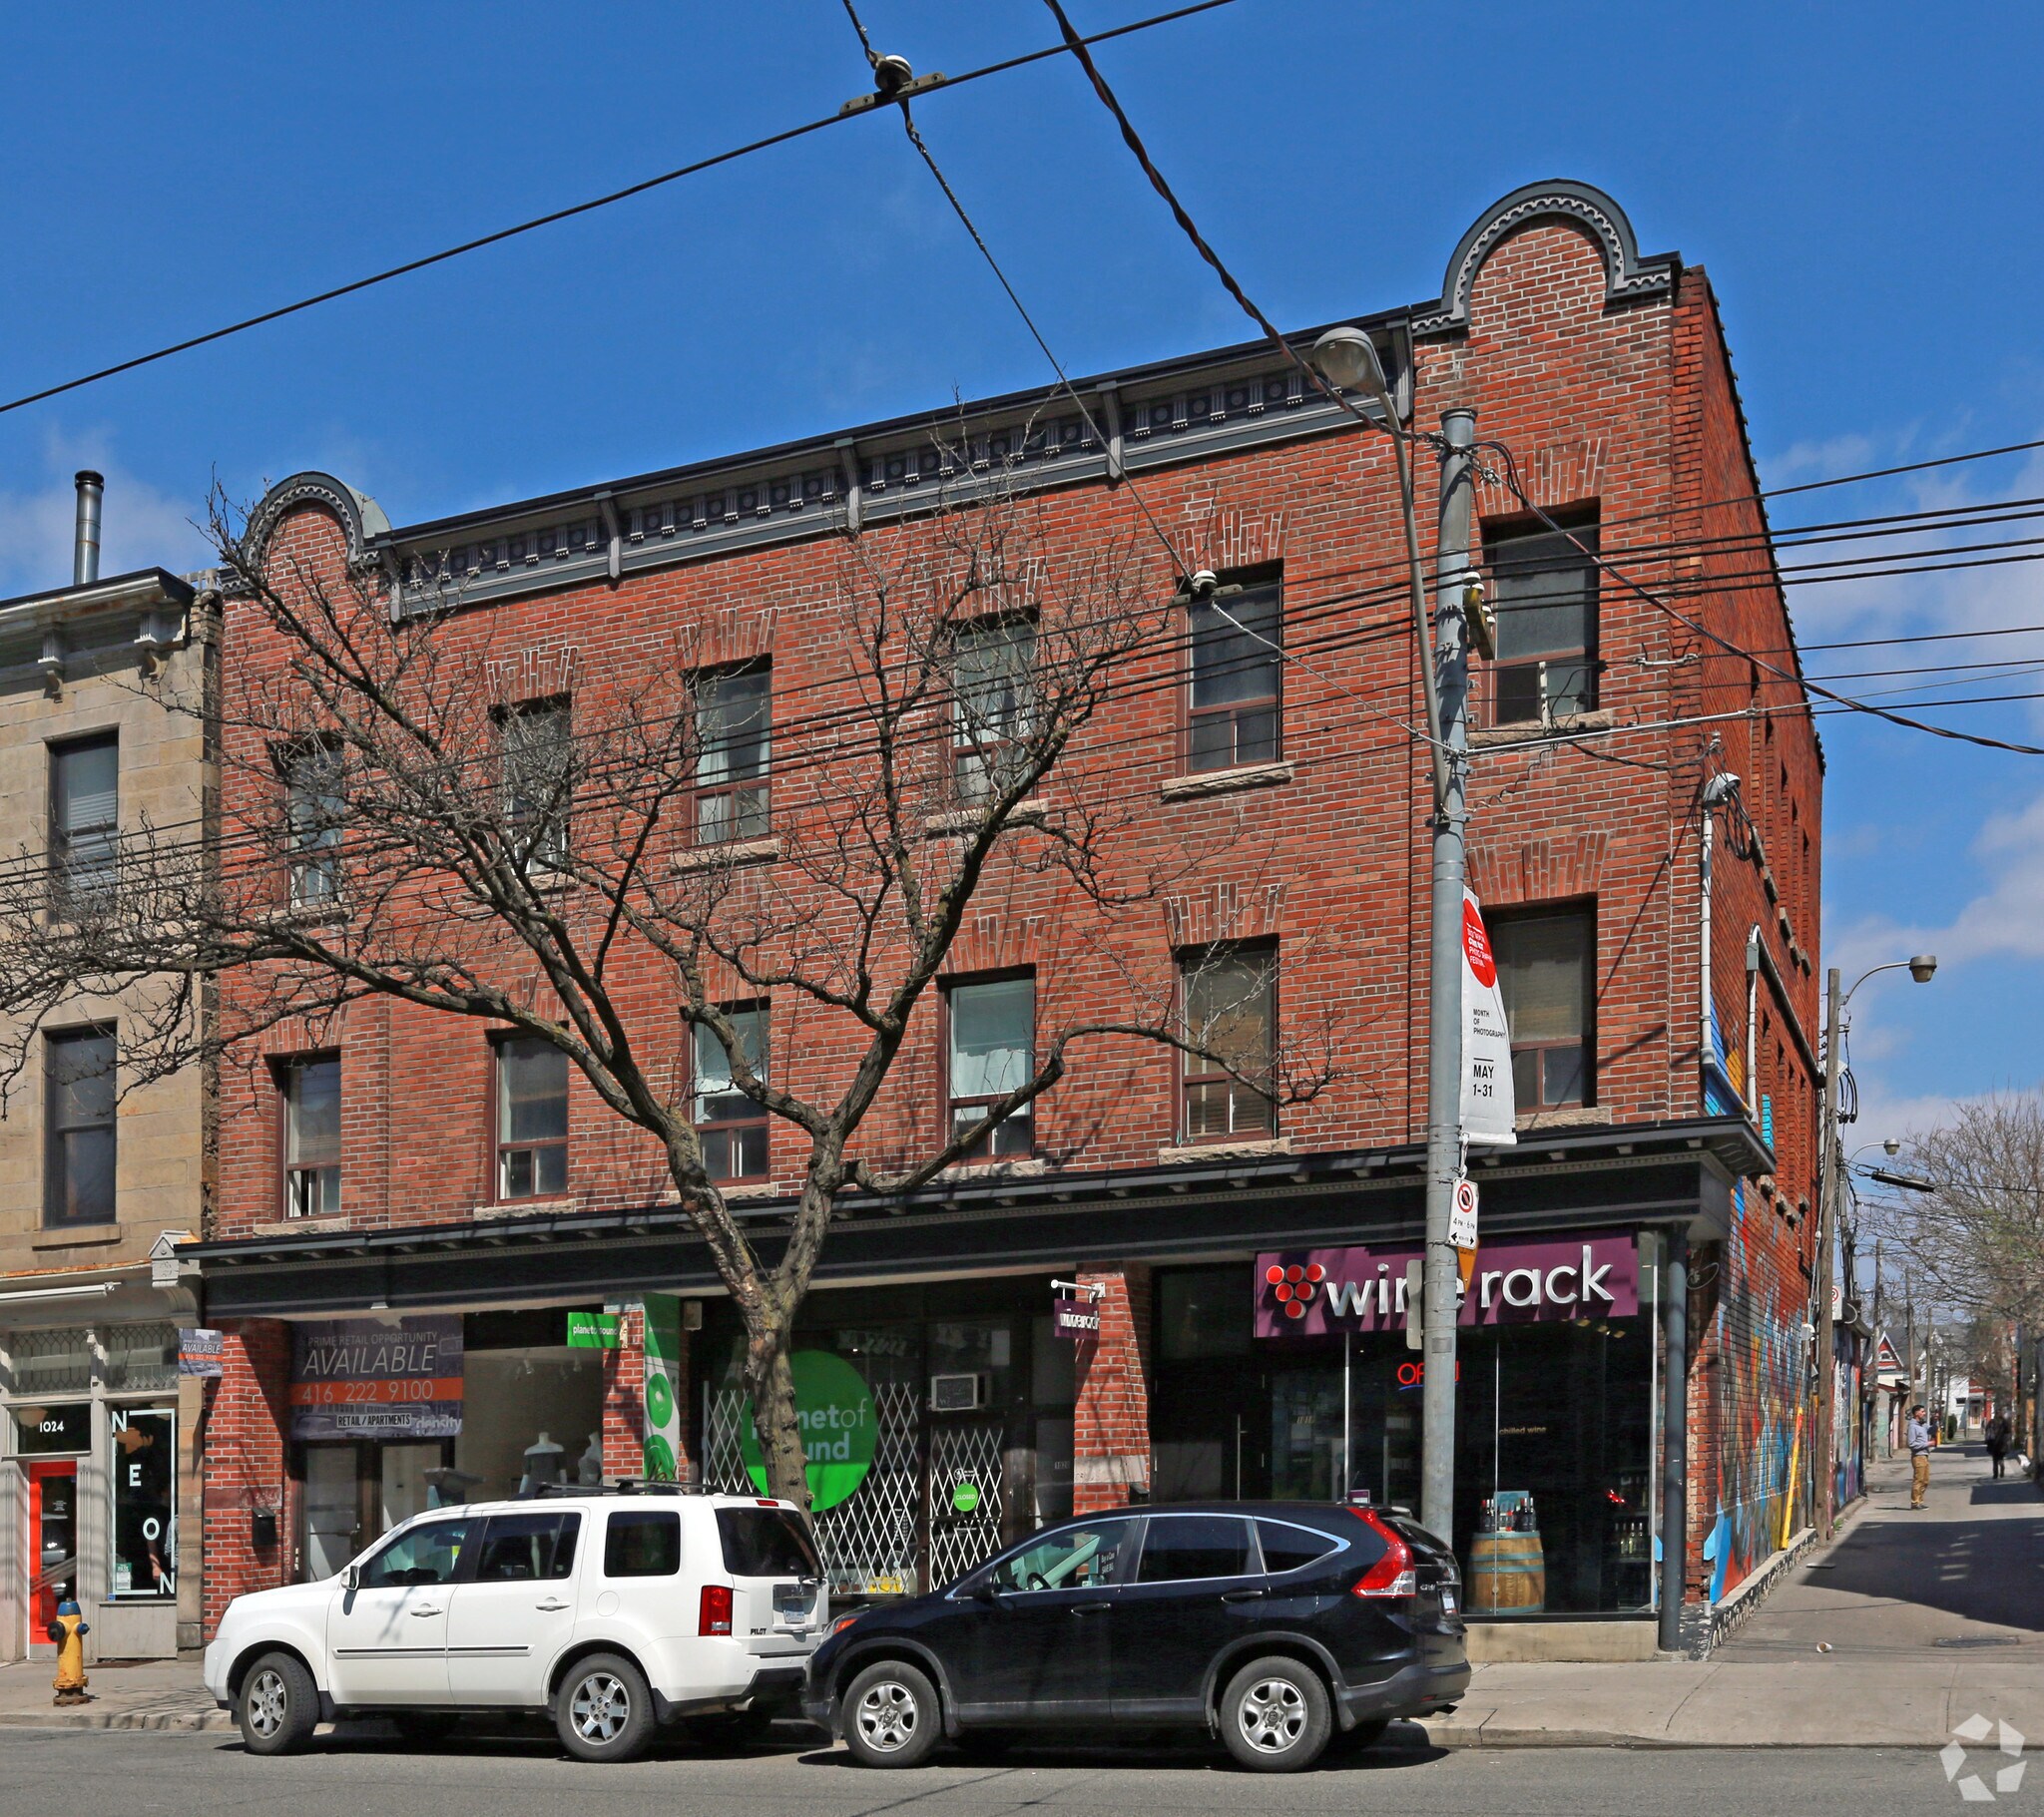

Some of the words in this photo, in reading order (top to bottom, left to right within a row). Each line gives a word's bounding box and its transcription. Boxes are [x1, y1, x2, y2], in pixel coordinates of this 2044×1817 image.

[1473, 1008, 1490, 1018] MONTH
[1473, 1027, 1506, 1039] PHOTOGRAPHY
[1473, 1064, 1494, 1080] MAY
[1472, 1084, 1493, 1098] 1-31
[1480, 1244, 1615, 1308] rack
[307, 1337, 336, 1347] PRIME
[339, 1335, 368, 1346] RETAIL
[370, 1331, 438, 1345] OPPORTUNITY
[182, 1343, 221, 1354] AVAILABLE
[302, 1344, 437, 1376] AVAILABLE
[302, 1385, 334, 1403] 416
[344, 1382, 377, 1402] 222
[388, 1380, 433, 1400] 9100
[39, 1421, 65, 1433] 1024
[416, 1415, 463, 1434] density
[1499, 1427, 1525, 1436] chilled
